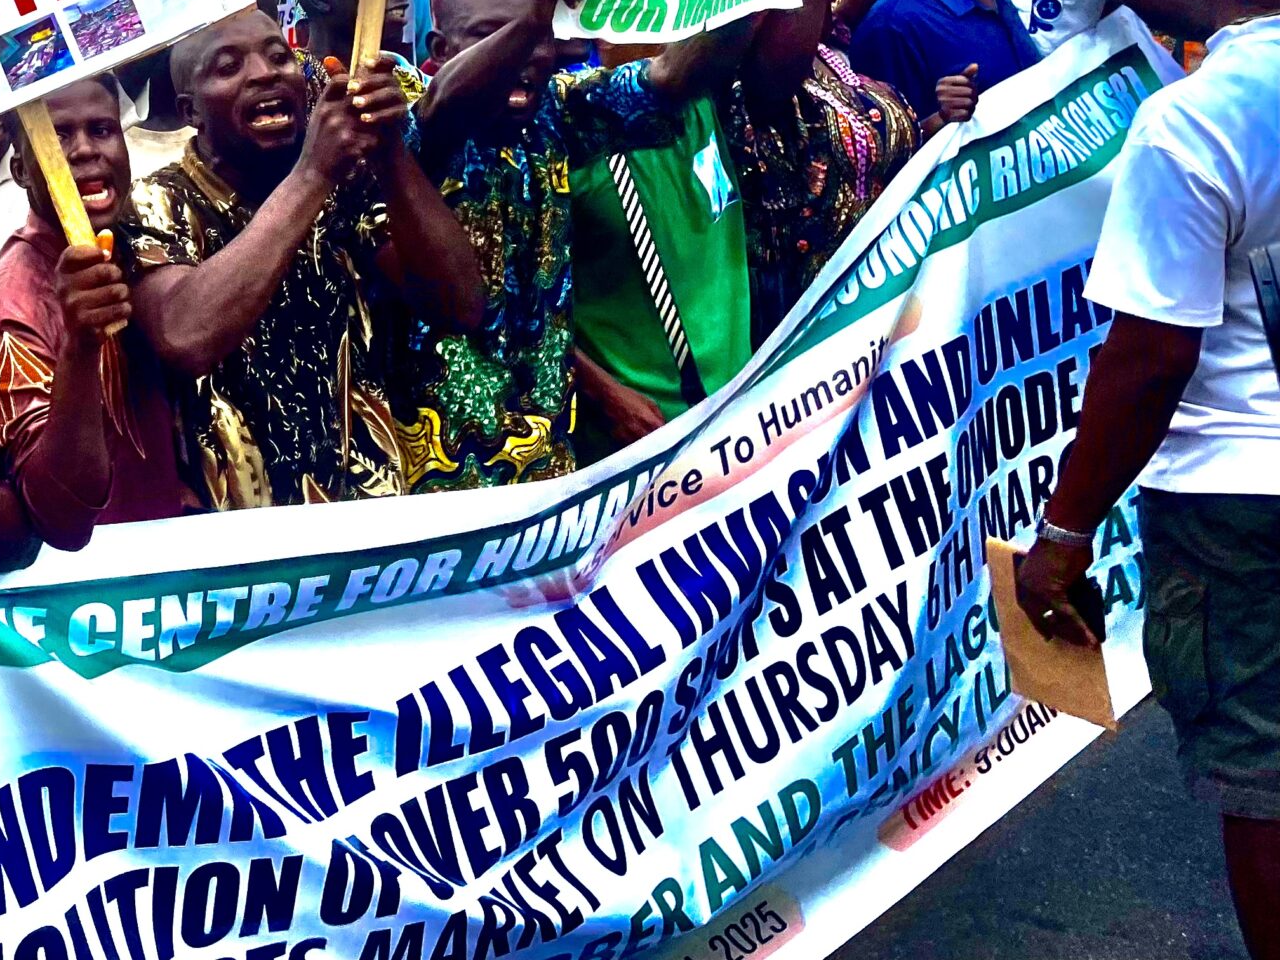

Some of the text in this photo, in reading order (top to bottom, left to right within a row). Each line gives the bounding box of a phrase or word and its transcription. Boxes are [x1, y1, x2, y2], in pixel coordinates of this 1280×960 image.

[710, 435, 755, 476] To
[67, 575, 329, 662] CENTRE
[335, 549, 462, 613] FOR
[222, 711, 376, 825] THE
[394, 585, 667, 778] ILLEGAL
[871, 334, 973, 460] AND
[370, 756, 540, 900] OVER
[545, 689, 664, 817] 500
[800, 505, 867, 616] AT
[858, 452, 955, 571] THE
[955, 359, 1081, 509] OWODE
[582, 760, 664, 877] ON
[666, 580, 914, 811] THURSDAY
[927, 516, 973, 632] 6TH
[699, 778, 821, 914] AND
[832, 687, 916, 798] THE
[900, 767, 972, 830] TIME:
